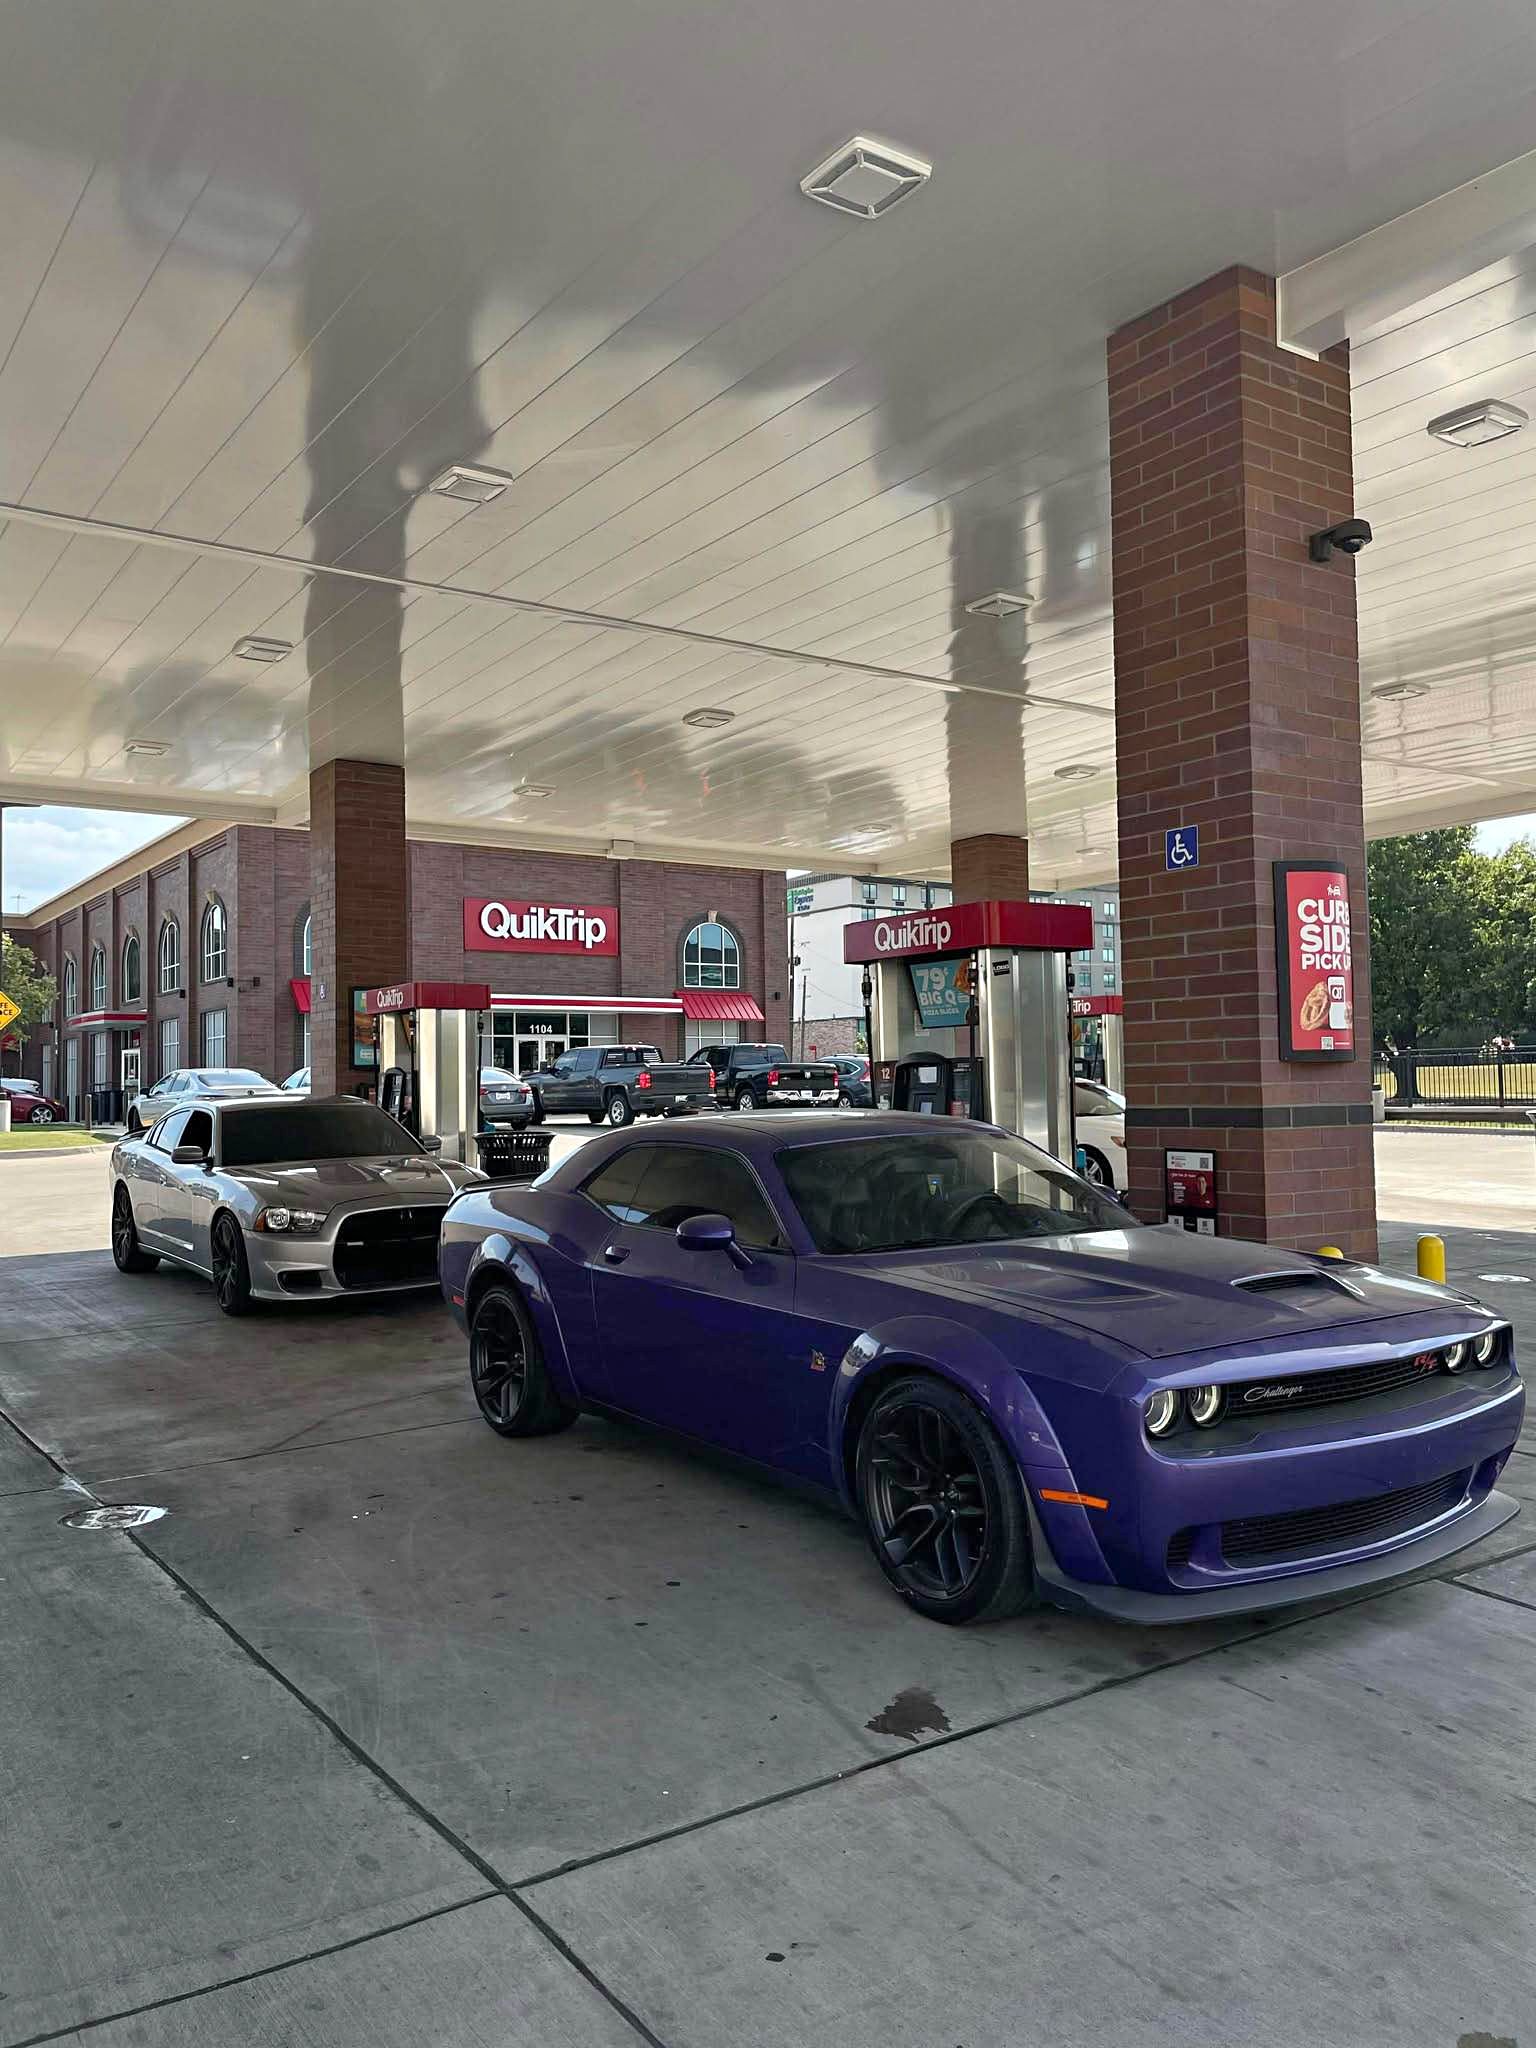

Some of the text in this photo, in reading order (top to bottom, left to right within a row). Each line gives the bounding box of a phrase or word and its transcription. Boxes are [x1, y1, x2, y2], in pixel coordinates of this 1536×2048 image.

[480, 902, 607, 949] QuikTrip
[874, 916, 951, 951] QuikTrip
[1300, 924, 1351, 954] SIDE
[377, 989, 404, 1008] QuikTrip
[920, 990, 943, 1006] BIG
[945, 989, 957, 1006] Q
[529, 1024, 553, 1034] 1104
[881, 1067, 891, 1080] 12
[1243, 1385, 1304, 1402] Challenger
